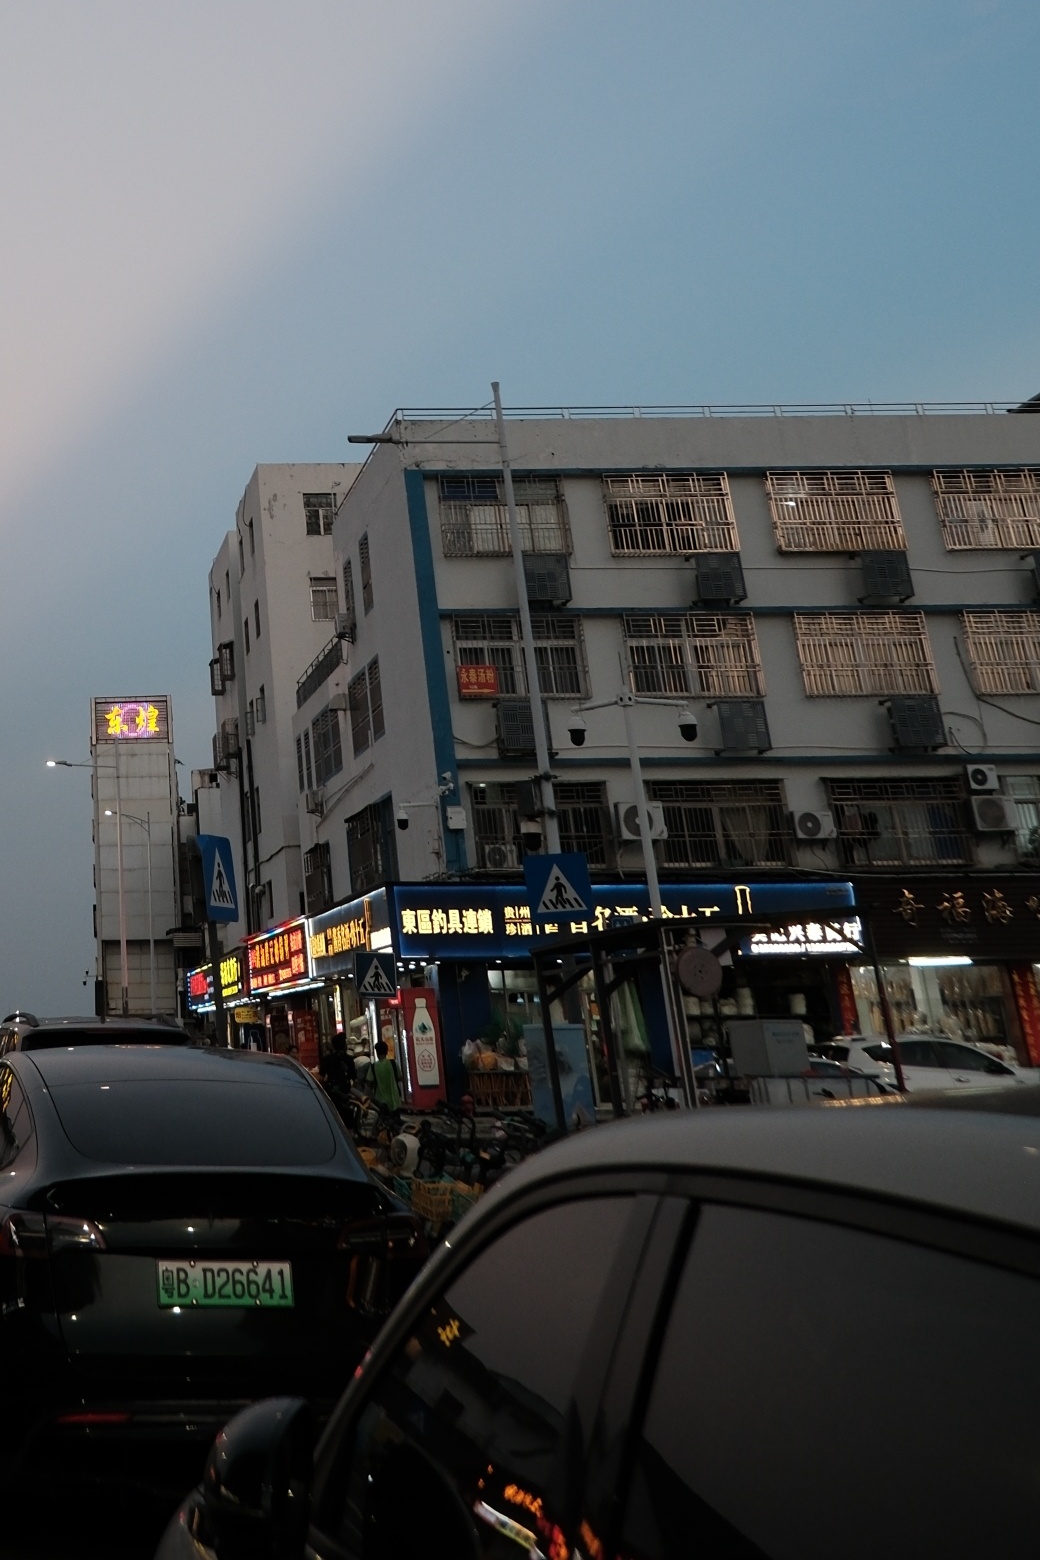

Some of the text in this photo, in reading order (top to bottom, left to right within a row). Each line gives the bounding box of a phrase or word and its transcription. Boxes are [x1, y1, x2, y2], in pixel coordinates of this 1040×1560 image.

[460, 668, 494, 683] 永泰汤粉
[401, 908, 493, 934] 東區釣具連鎖
